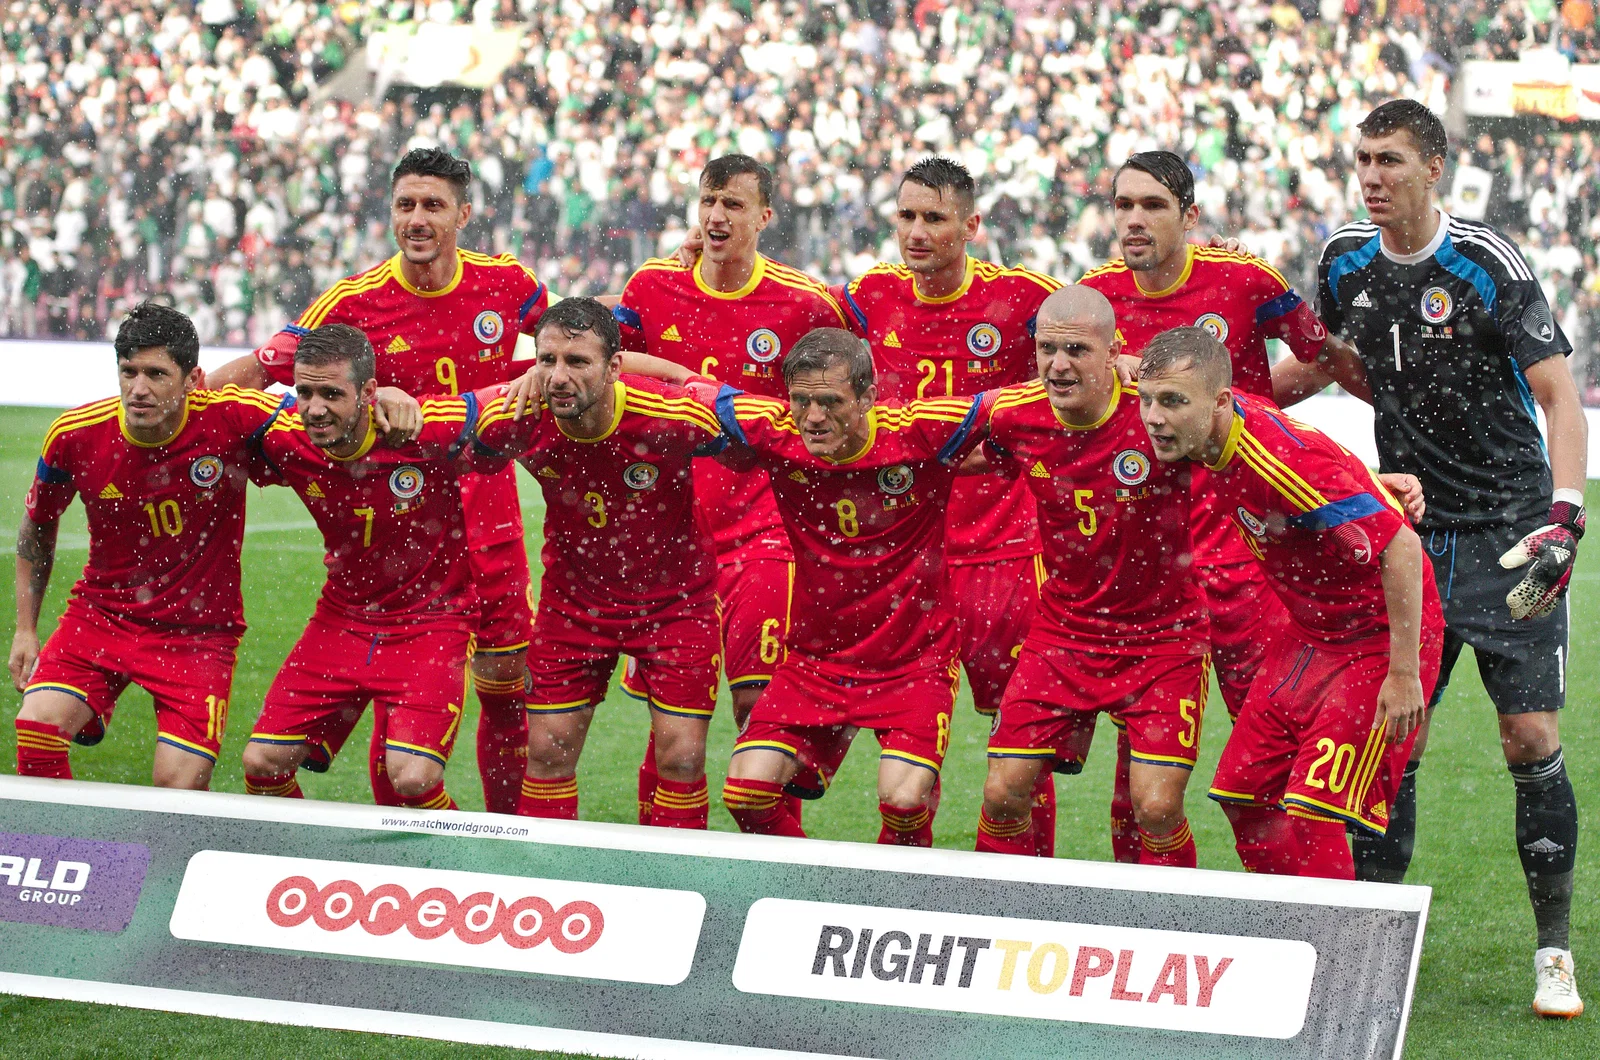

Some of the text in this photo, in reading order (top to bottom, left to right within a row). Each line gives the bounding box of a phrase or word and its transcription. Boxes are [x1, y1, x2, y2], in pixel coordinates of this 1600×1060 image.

[1352, 300, 1372, 308] adidas
[1389, 323, 1402, 371] 1
[435, 356, 458, 397] 9
[917, 359, 953, 397] 21
[143, 499, 184, 537] 10
[353, 507, 375, 548] 7
[583, 491, 608, 528] 3
[836, 498, 860, 537] 8
[1074, 489, 1098, 537] 5
[760, 618, 780, 664] 6
[1555, 644, 1564, 694] 1
[205, 694, 227, 745] 10
[439, 702, 461, 747] 7
[936, 712, 950, 758] 8
[1178, 698, 1197, 748] 5
[1304, 737, 1357, 794] 20
[381, 817, 529, 836] www.matchworldgroup.com
[19, 889, 82, 906] GROUP
[275, 885, 594, 944] ooredoo
